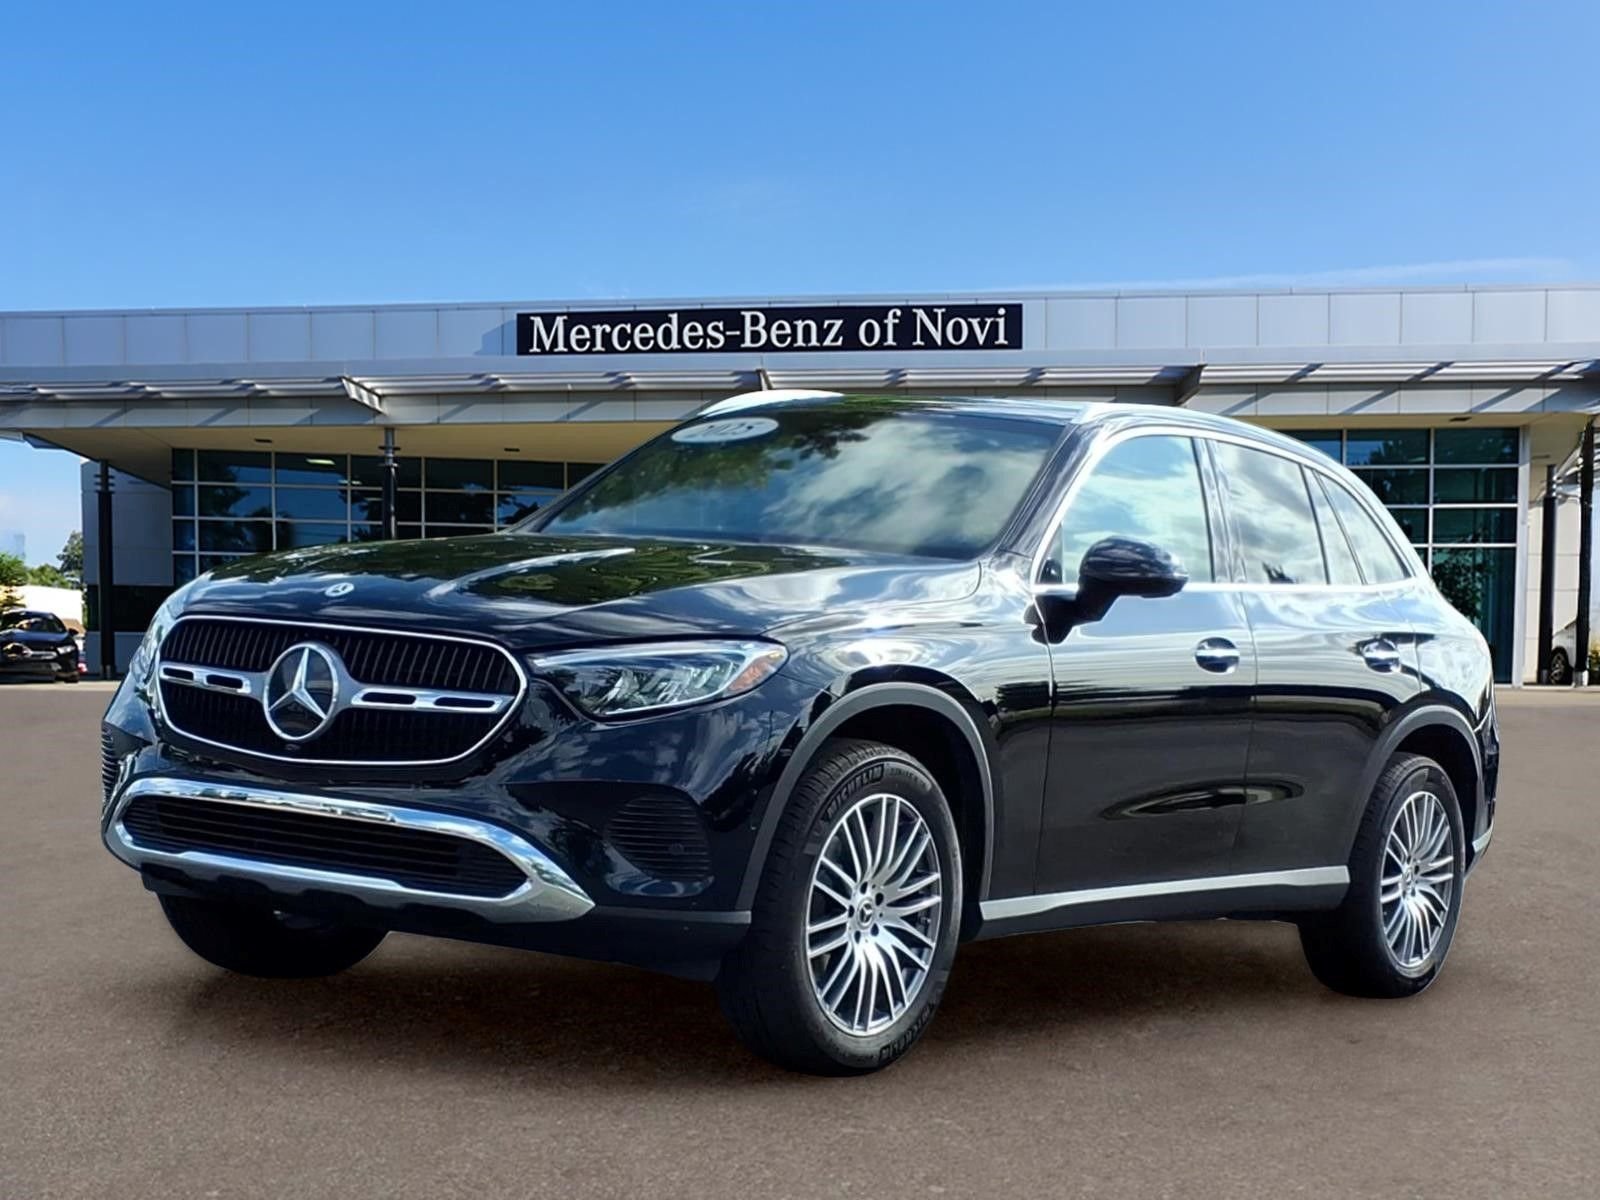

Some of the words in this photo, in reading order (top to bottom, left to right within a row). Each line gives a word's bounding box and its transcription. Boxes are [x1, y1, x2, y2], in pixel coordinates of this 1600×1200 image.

[529, 310, 844, 353] Mercedes-Benz
[858, 308, 902, 347] of
[912, 307, 1009, 346] Novi
